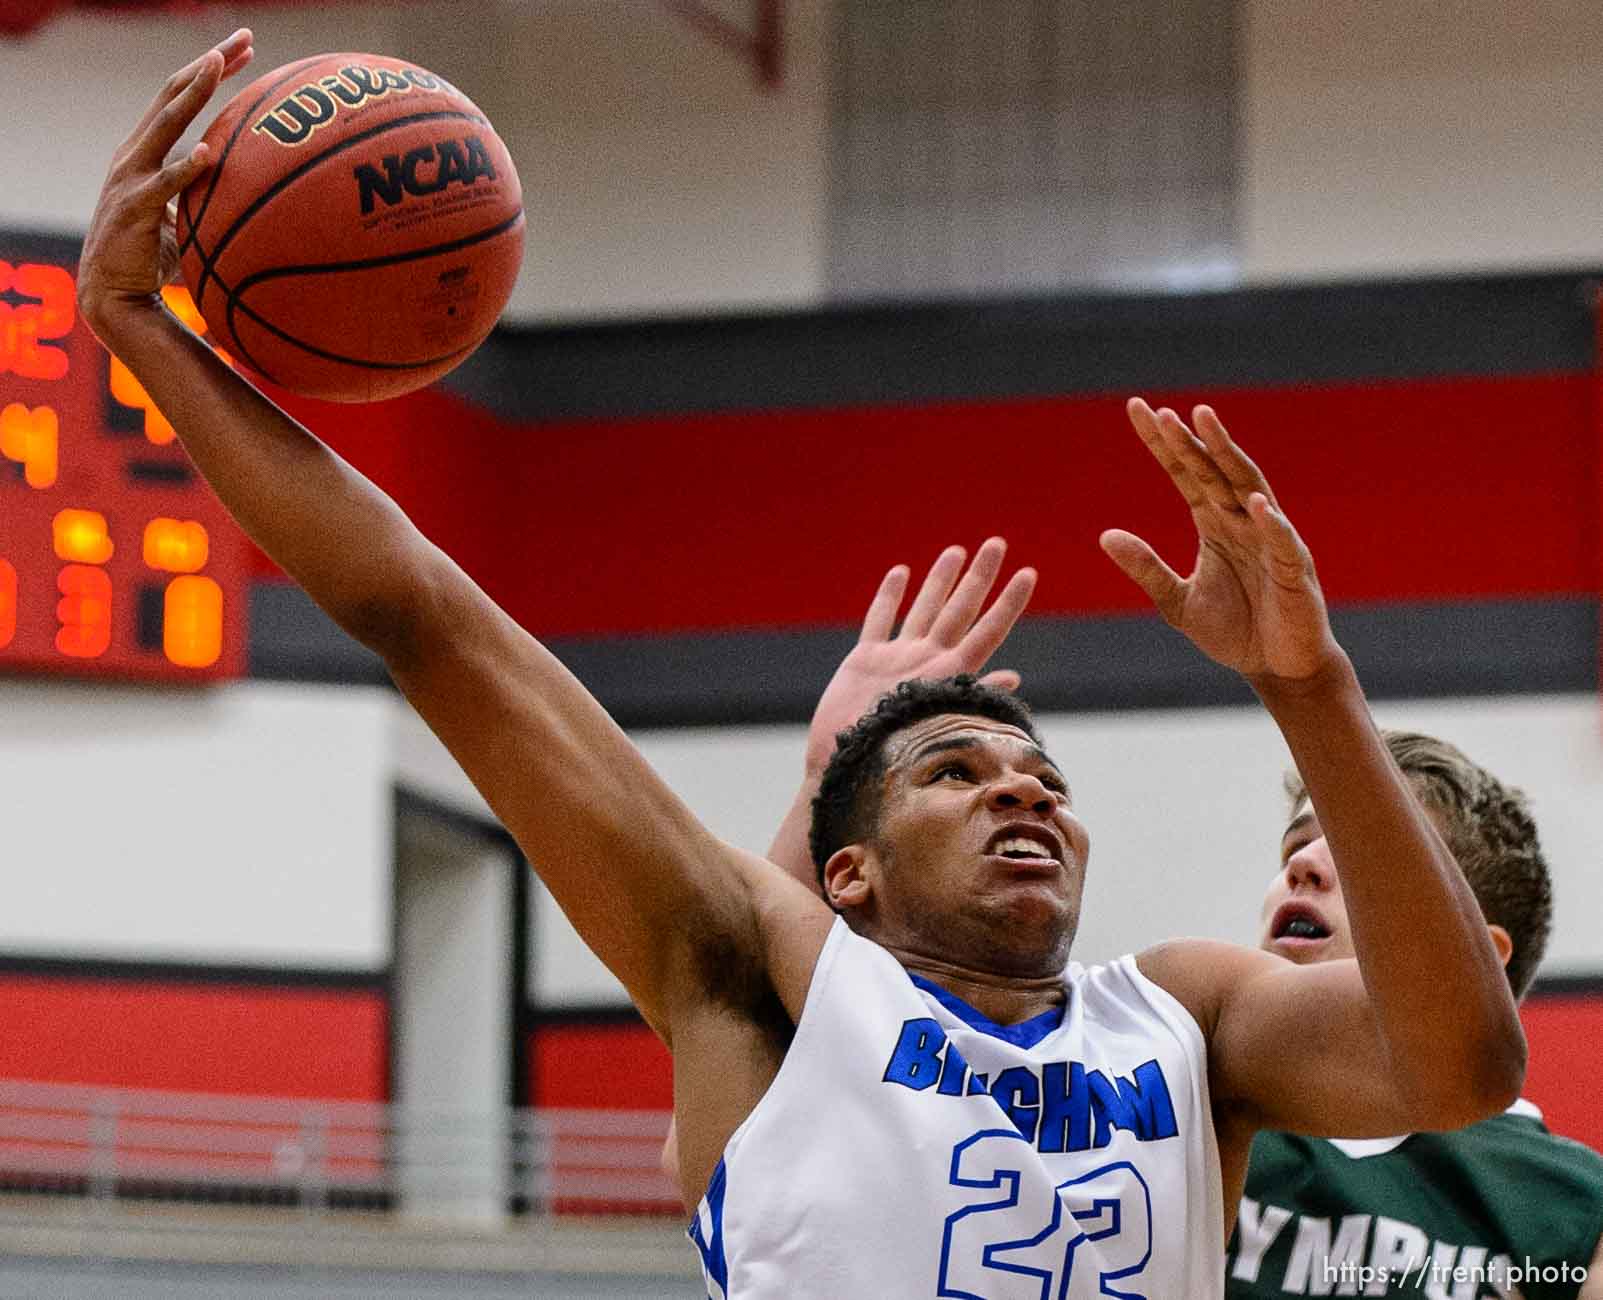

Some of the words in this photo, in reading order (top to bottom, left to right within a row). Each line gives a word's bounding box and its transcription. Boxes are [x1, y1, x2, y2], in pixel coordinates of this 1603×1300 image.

[354, 137, 496, 215] NCAA
[882, 1017, 1179, 1153] BIGHAM
[937, 1129, 1152, 1300] 22
[1226, 1196, 1525, 1300] YMPUS
